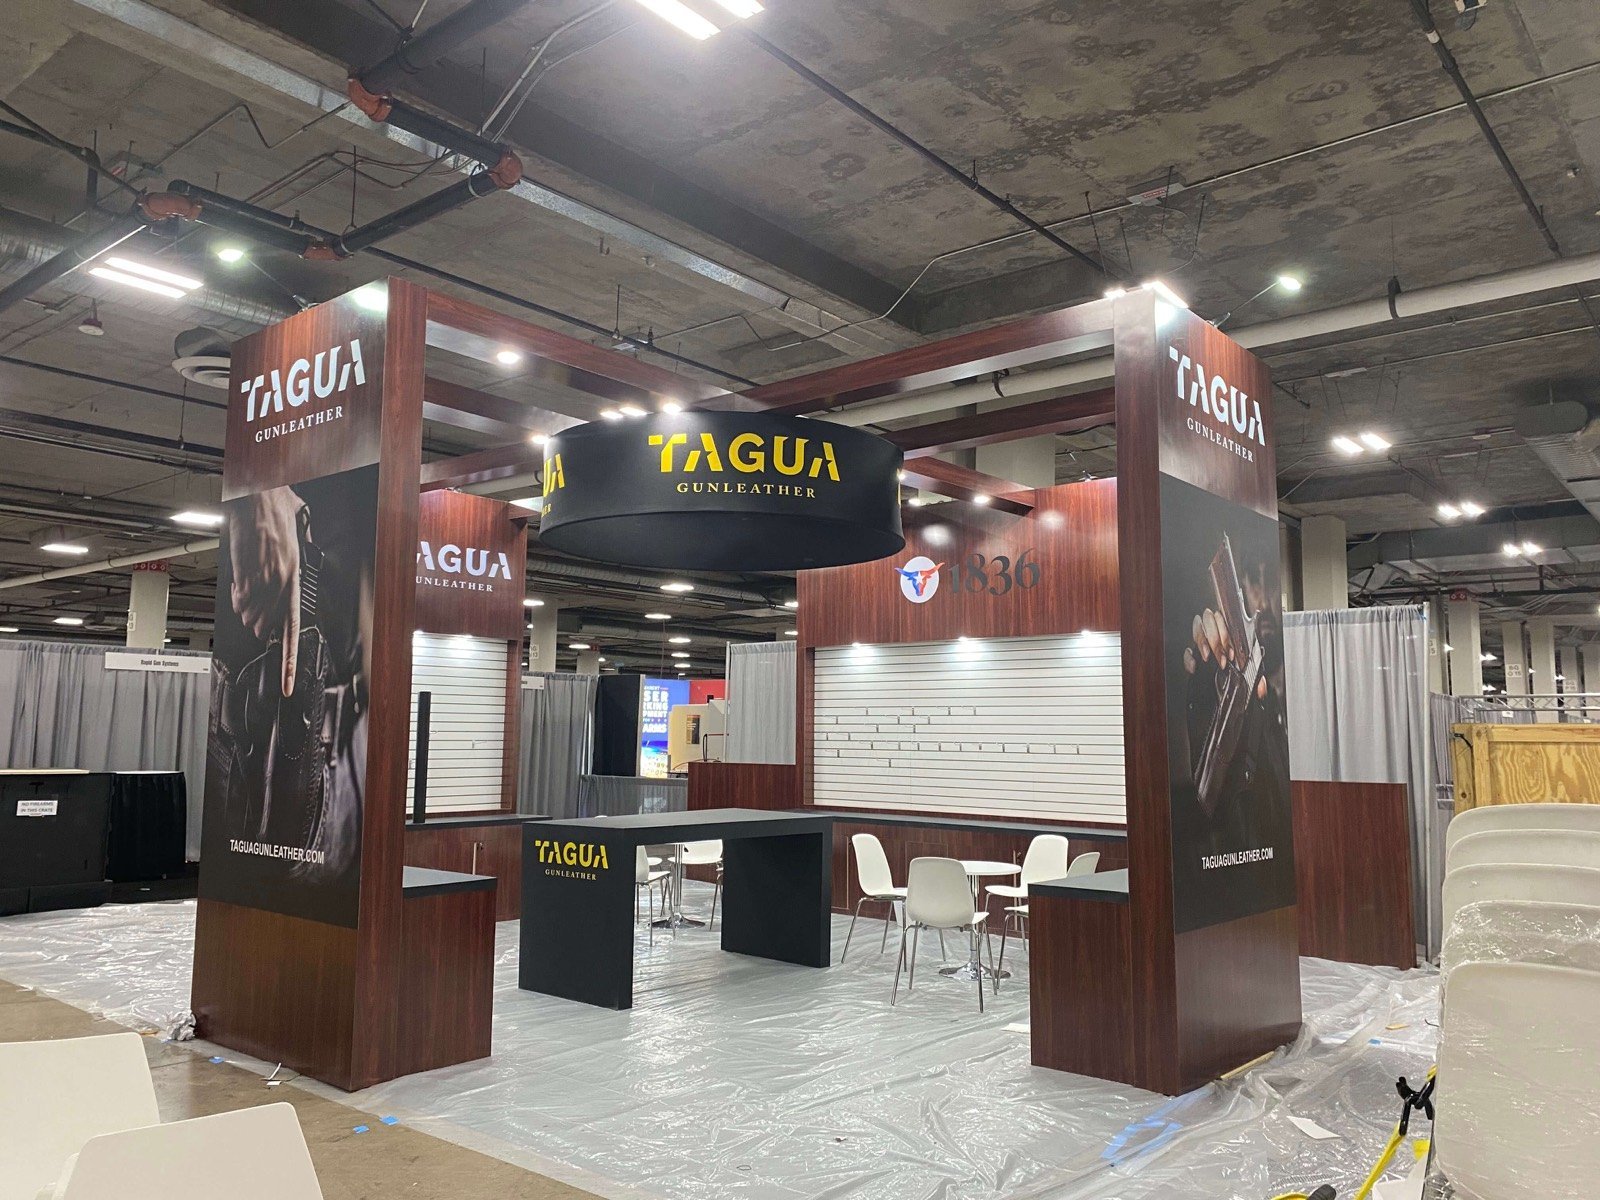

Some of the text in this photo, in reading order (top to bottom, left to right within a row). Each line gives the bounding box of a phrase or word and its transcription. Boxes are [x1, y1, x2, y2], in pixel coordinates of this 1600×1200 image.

[241, 339, 366, 422] TAGUA
[1169, 346, 1266, 446] TAGUA
[255, 405, 343, 443] GUNLEATHER
[1187, 417, 1254, 463] GUNLEATHER
[648, 432, 841, 482] TAGUA
[677, 482, 816, 499] GUNLEATHER
[416, 541, 512, 580] AGUA
[948, 547, 1041, 596] 1836
[415, 576, 494, 593] UNLEATHER
[643, 690, 669, 702] SER
[229, 839, 325, 864] TAGUAGUNLEATHER.COM
[535, 840, 609, 869] TAGUA
[1201, 847, 1274, 870] TAGUAGUNLEATHER.COM
[545, 868, 597, 881] GUNLEATHER
